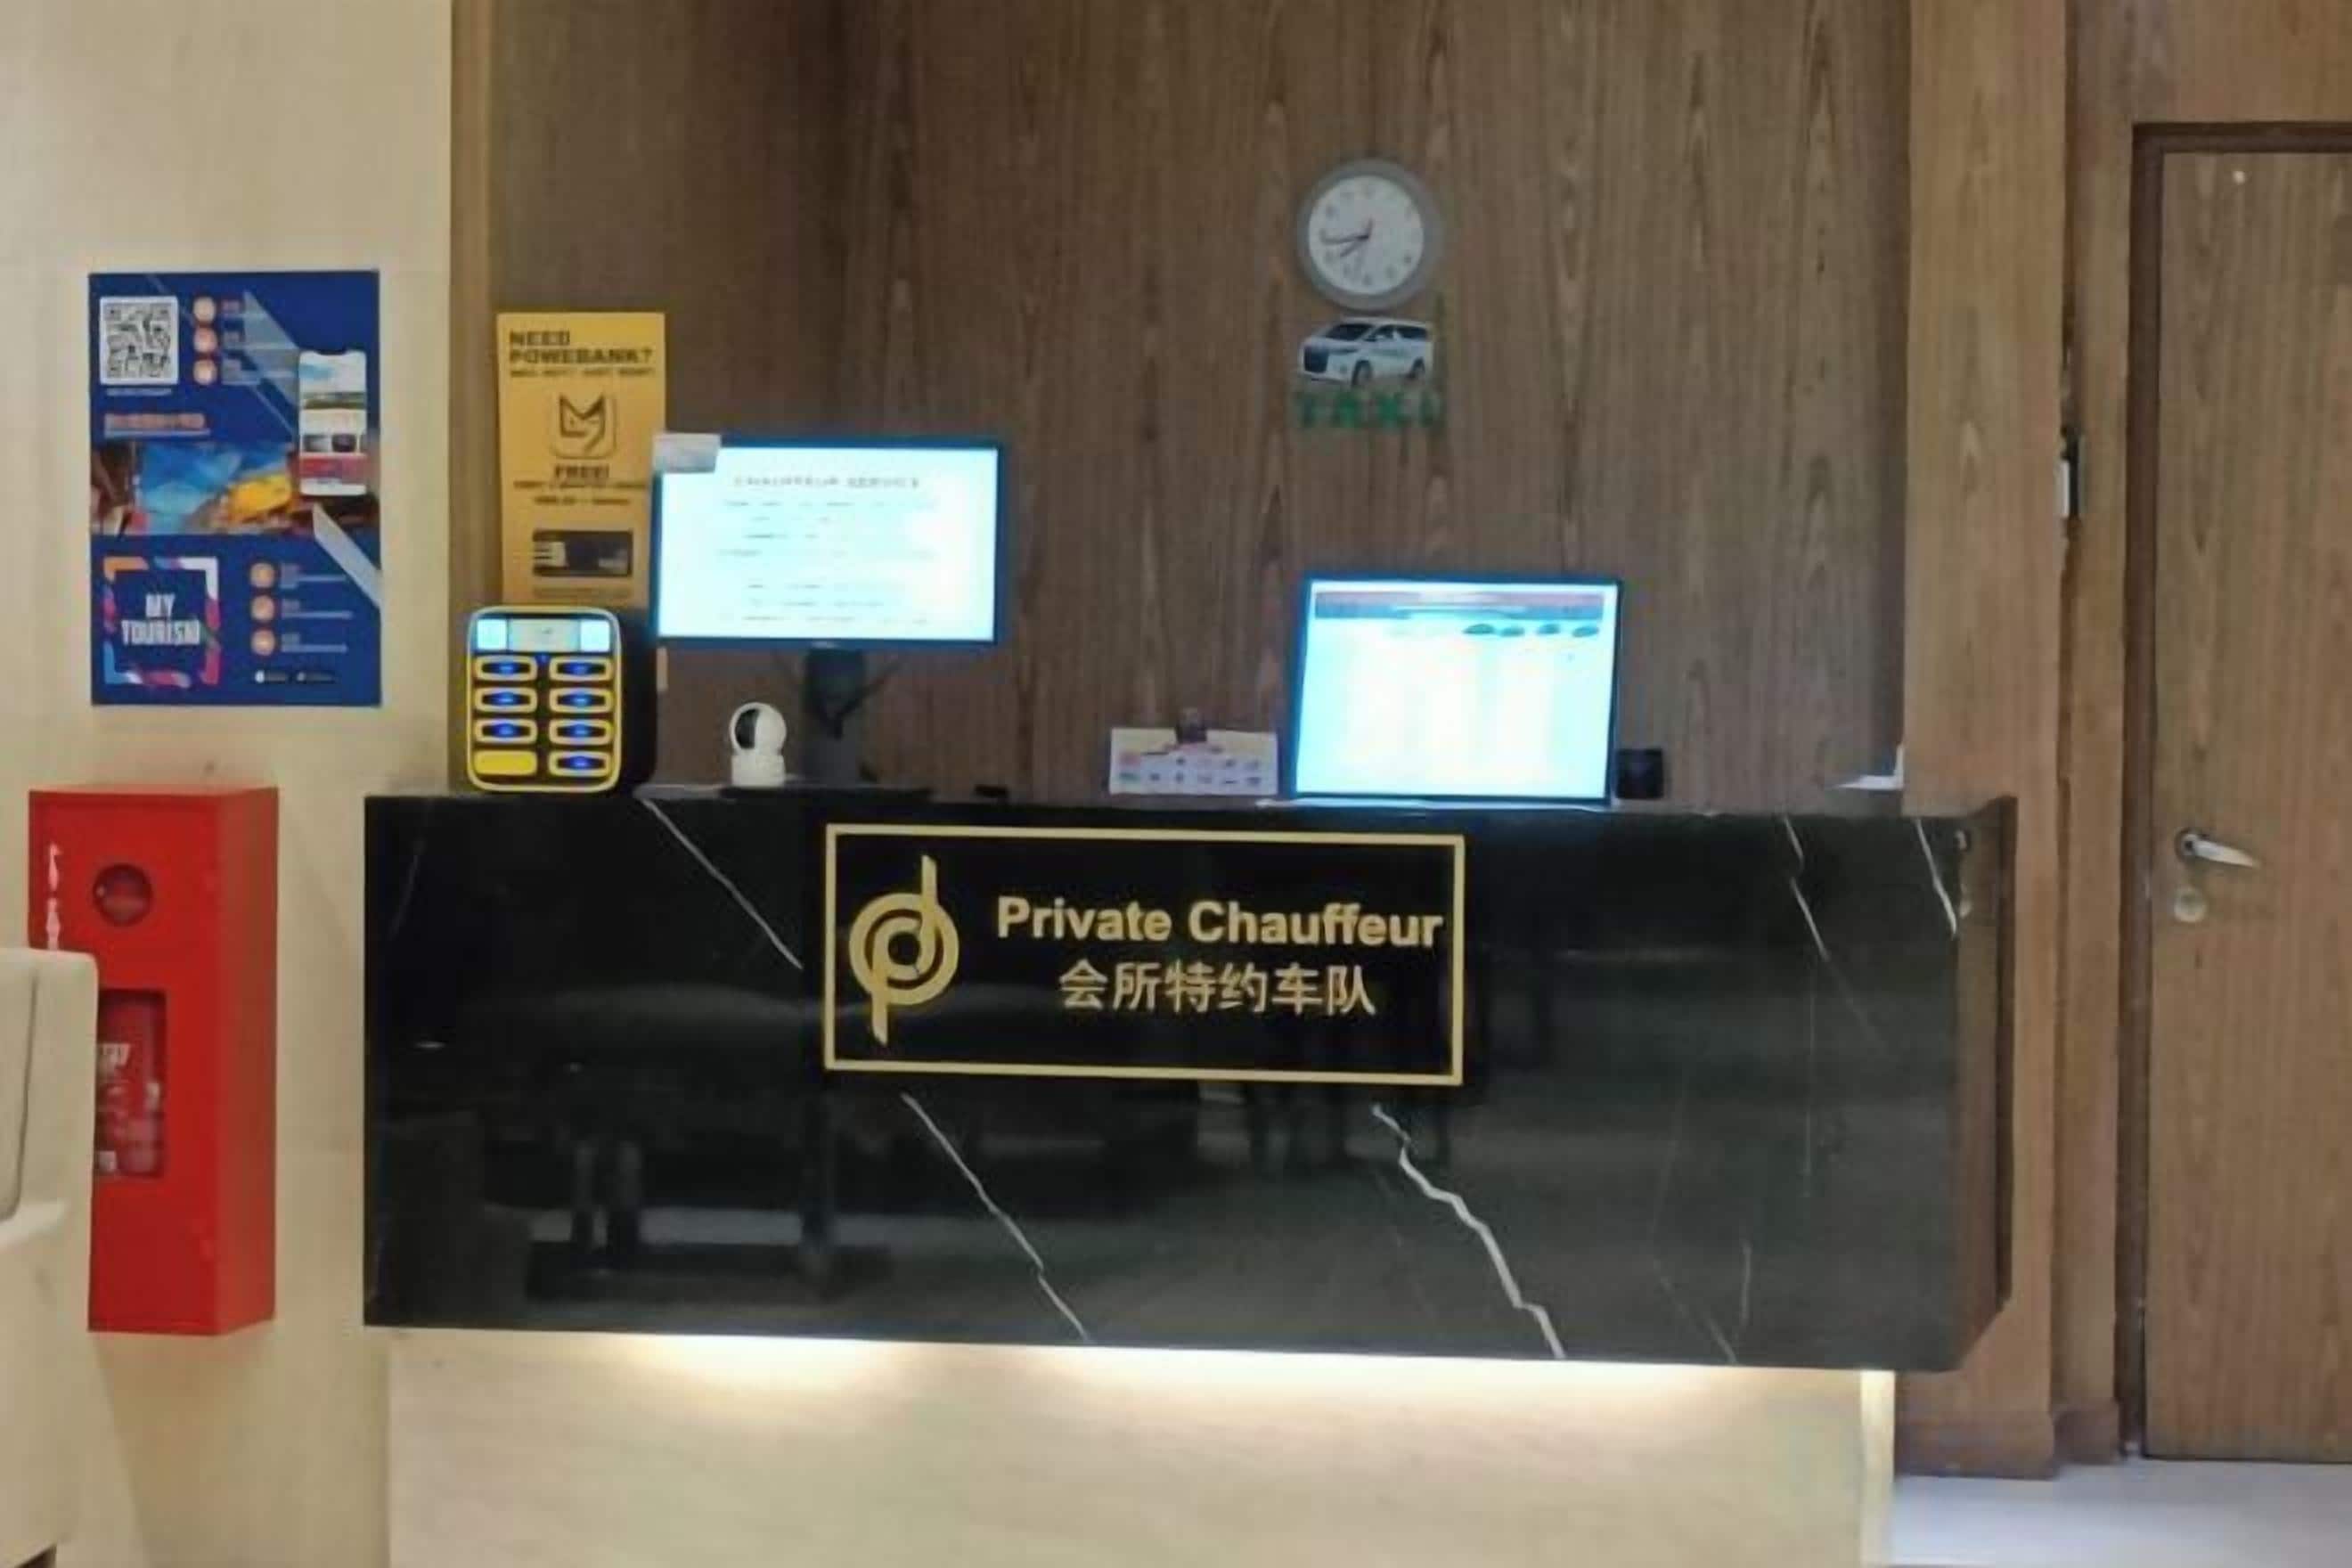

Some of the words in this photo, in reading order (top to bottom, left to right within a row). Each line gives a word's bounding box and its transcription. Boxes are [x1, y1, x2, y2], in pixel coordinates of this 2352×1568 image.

[509, 330, 571, 347] NEED
[997, 895, 1172, 942] Private
[1188, 900, 1445, 948] Chauffeur
[1058, 959, 1376, 1017] 会所特约车队
